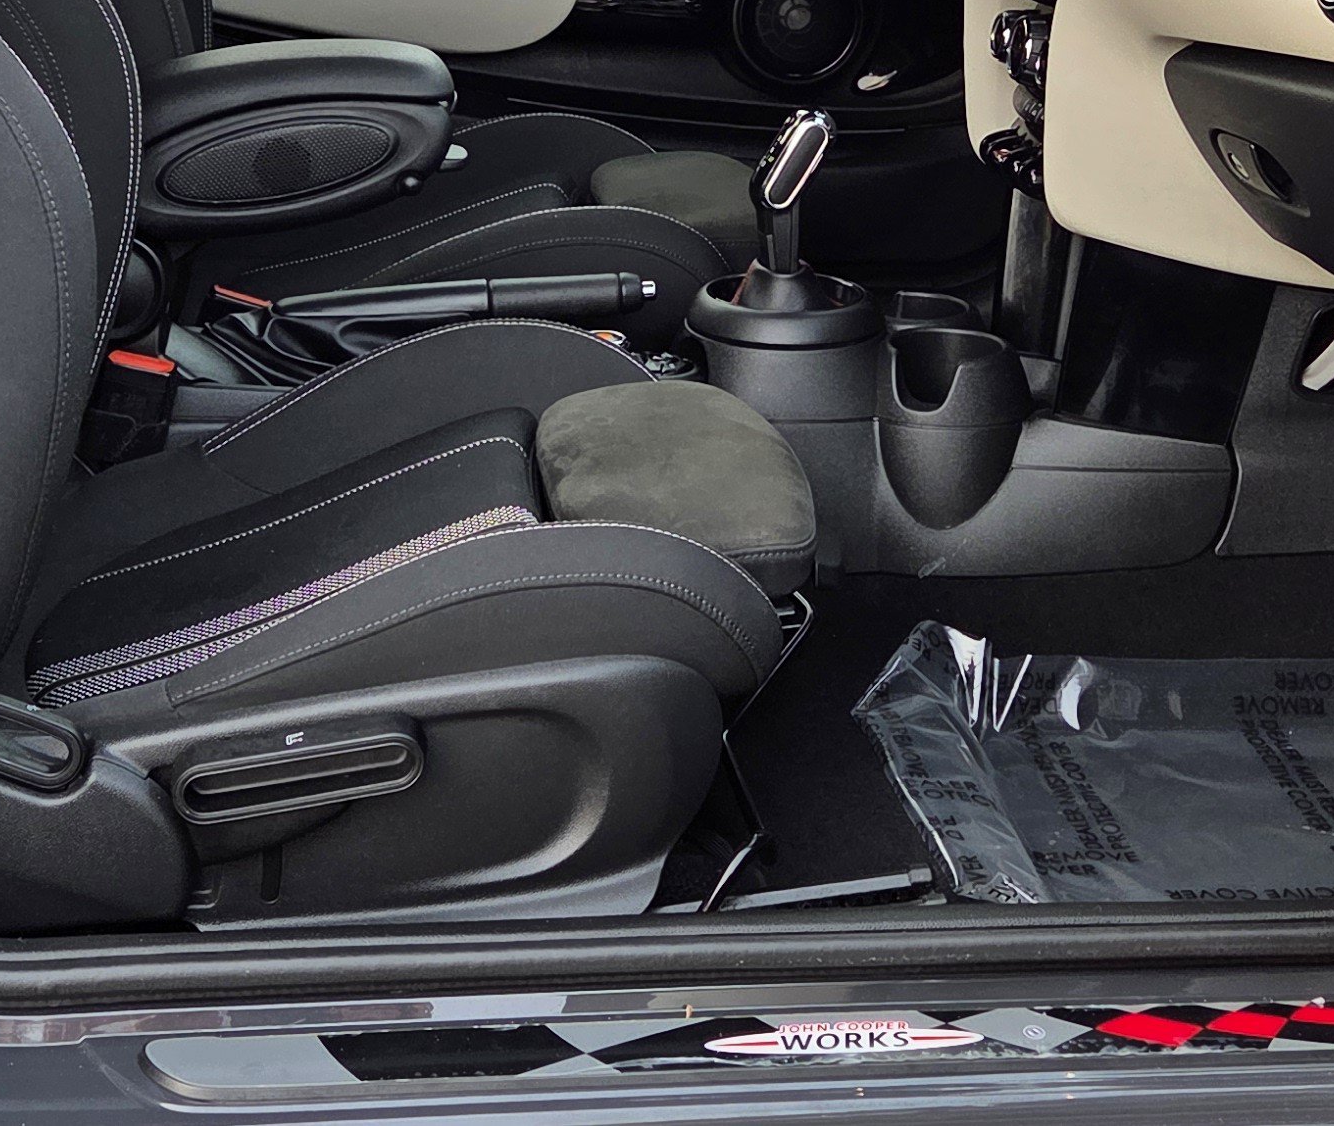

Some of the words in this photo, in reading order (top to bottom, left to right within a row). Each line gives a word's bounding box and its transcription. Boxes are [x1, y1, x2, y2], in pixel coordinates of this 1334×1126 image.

[1232, 695, 1325, 716] REMOVE
[1286, 787, 1333, 834] COVER
[1163, 887, 1259, 903] COVER
[779, 1024, 828, 1033] JOHN
[836, 1021, 907, 1031] COOPER
[780, 1031, 910, 1050] WORKS
